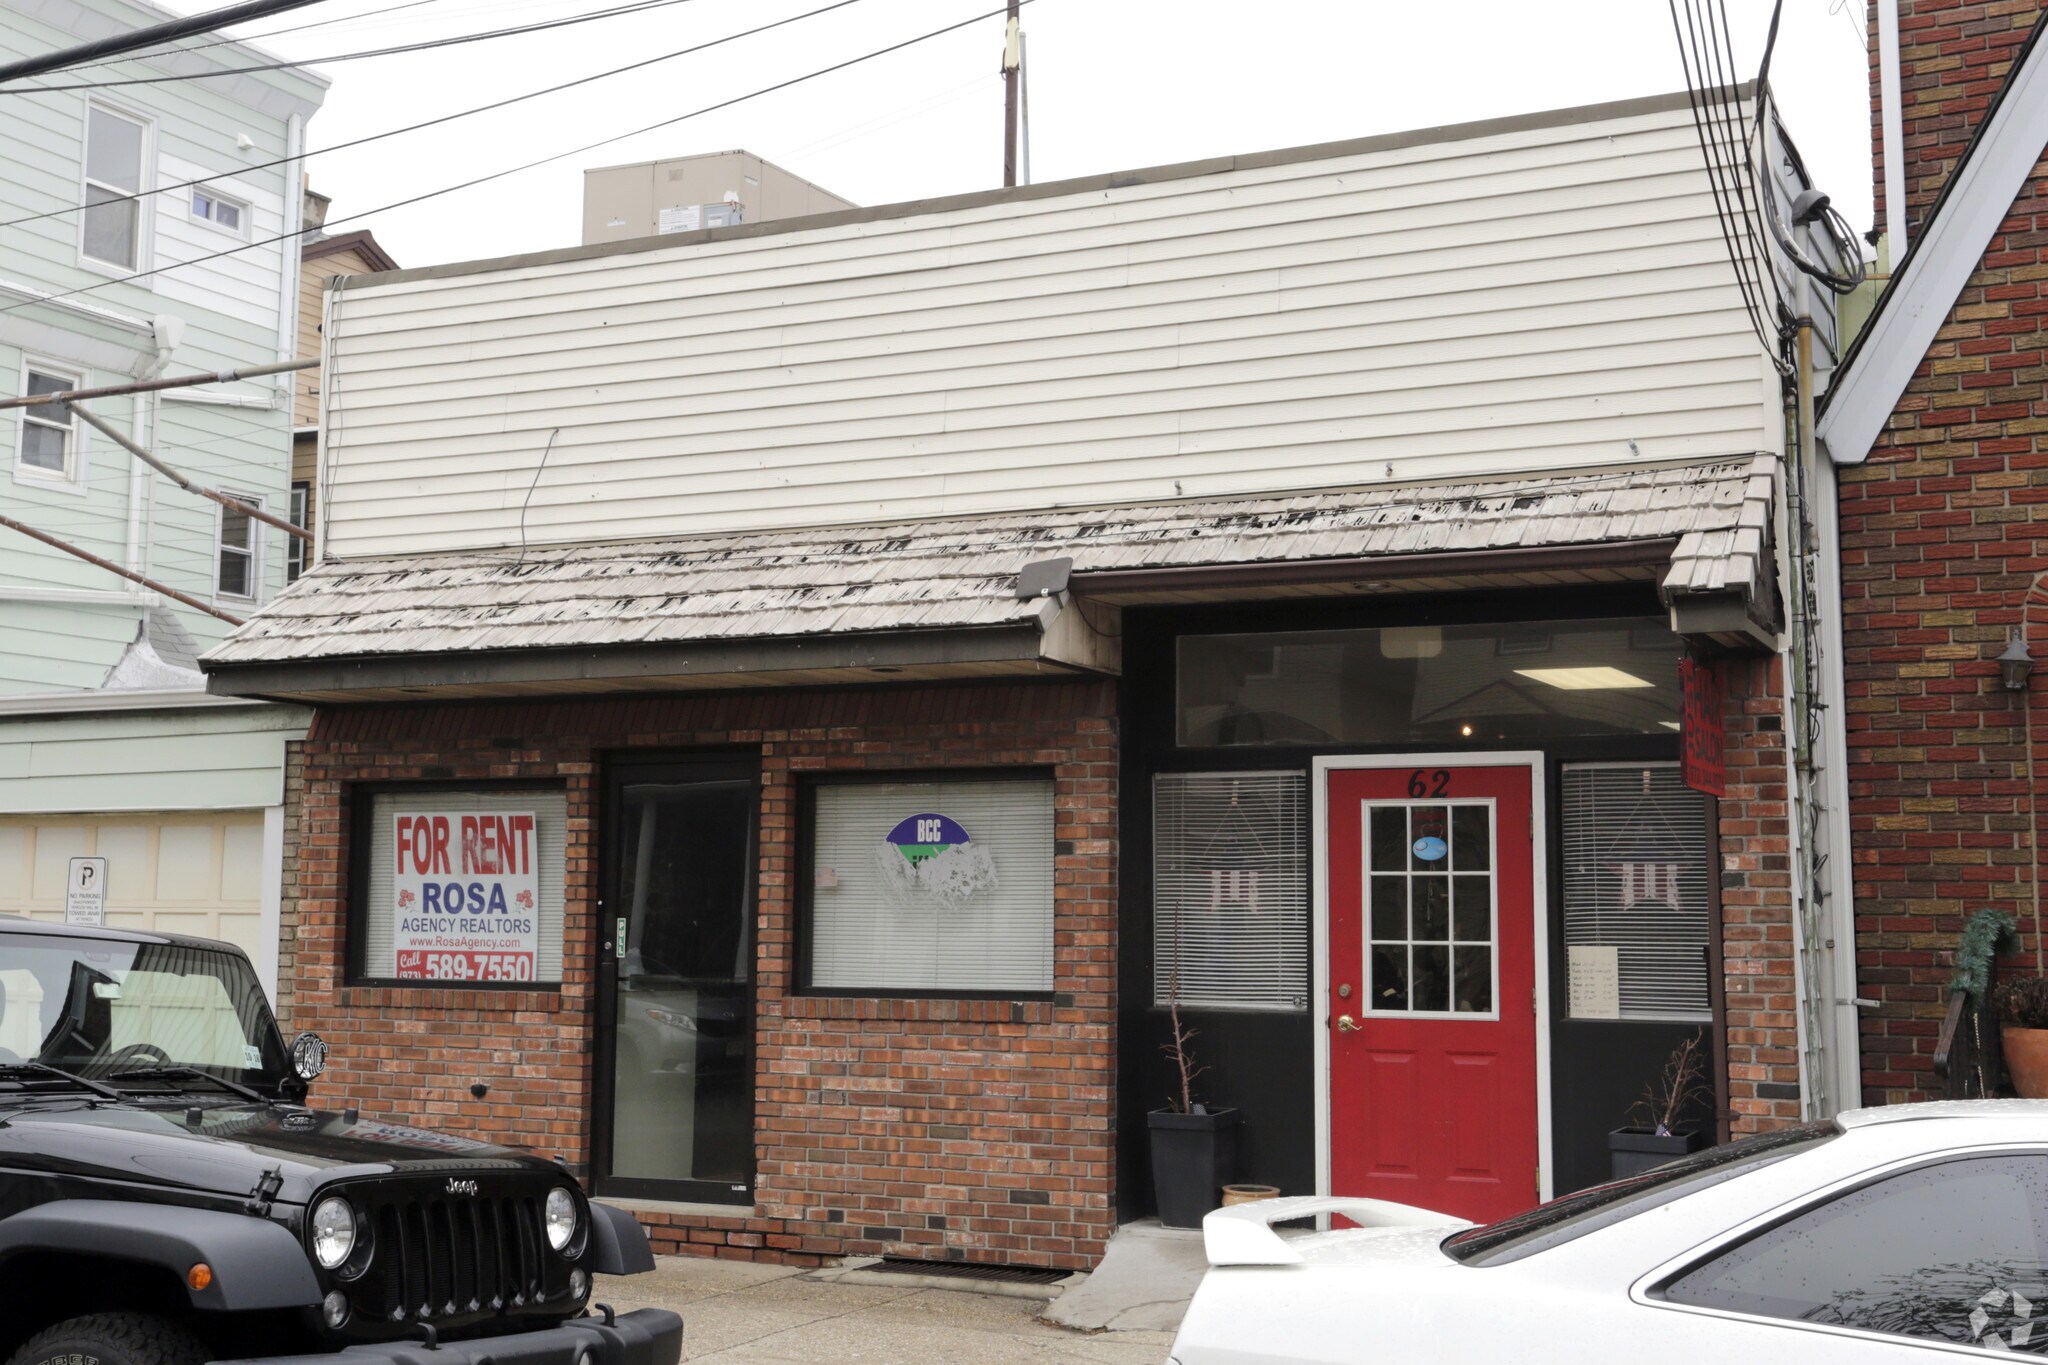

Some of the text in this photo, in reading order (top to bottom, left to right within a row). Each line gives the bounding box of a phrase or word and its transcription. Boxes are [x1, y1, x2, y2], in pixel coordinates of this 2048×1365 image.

[1407, 769, 1452, 799] 62
[917, 818, 941, 843] BCC
[397, 815, 534, 875] FOR RENT
[79, 892, 101, 900] PARKING
[422, 882, 508, 915] ROSA
[401, 917, 531, 934] AGENCY REALTORS
[409, 936, 521, 950] www.RosaAgency.com
[400, 951, 421, 969] Call
[425, 954, 530, 981] 589-7550
[303, 1038, 328, 1077] KC
[445, 1177, 478, 1197] Jeep
